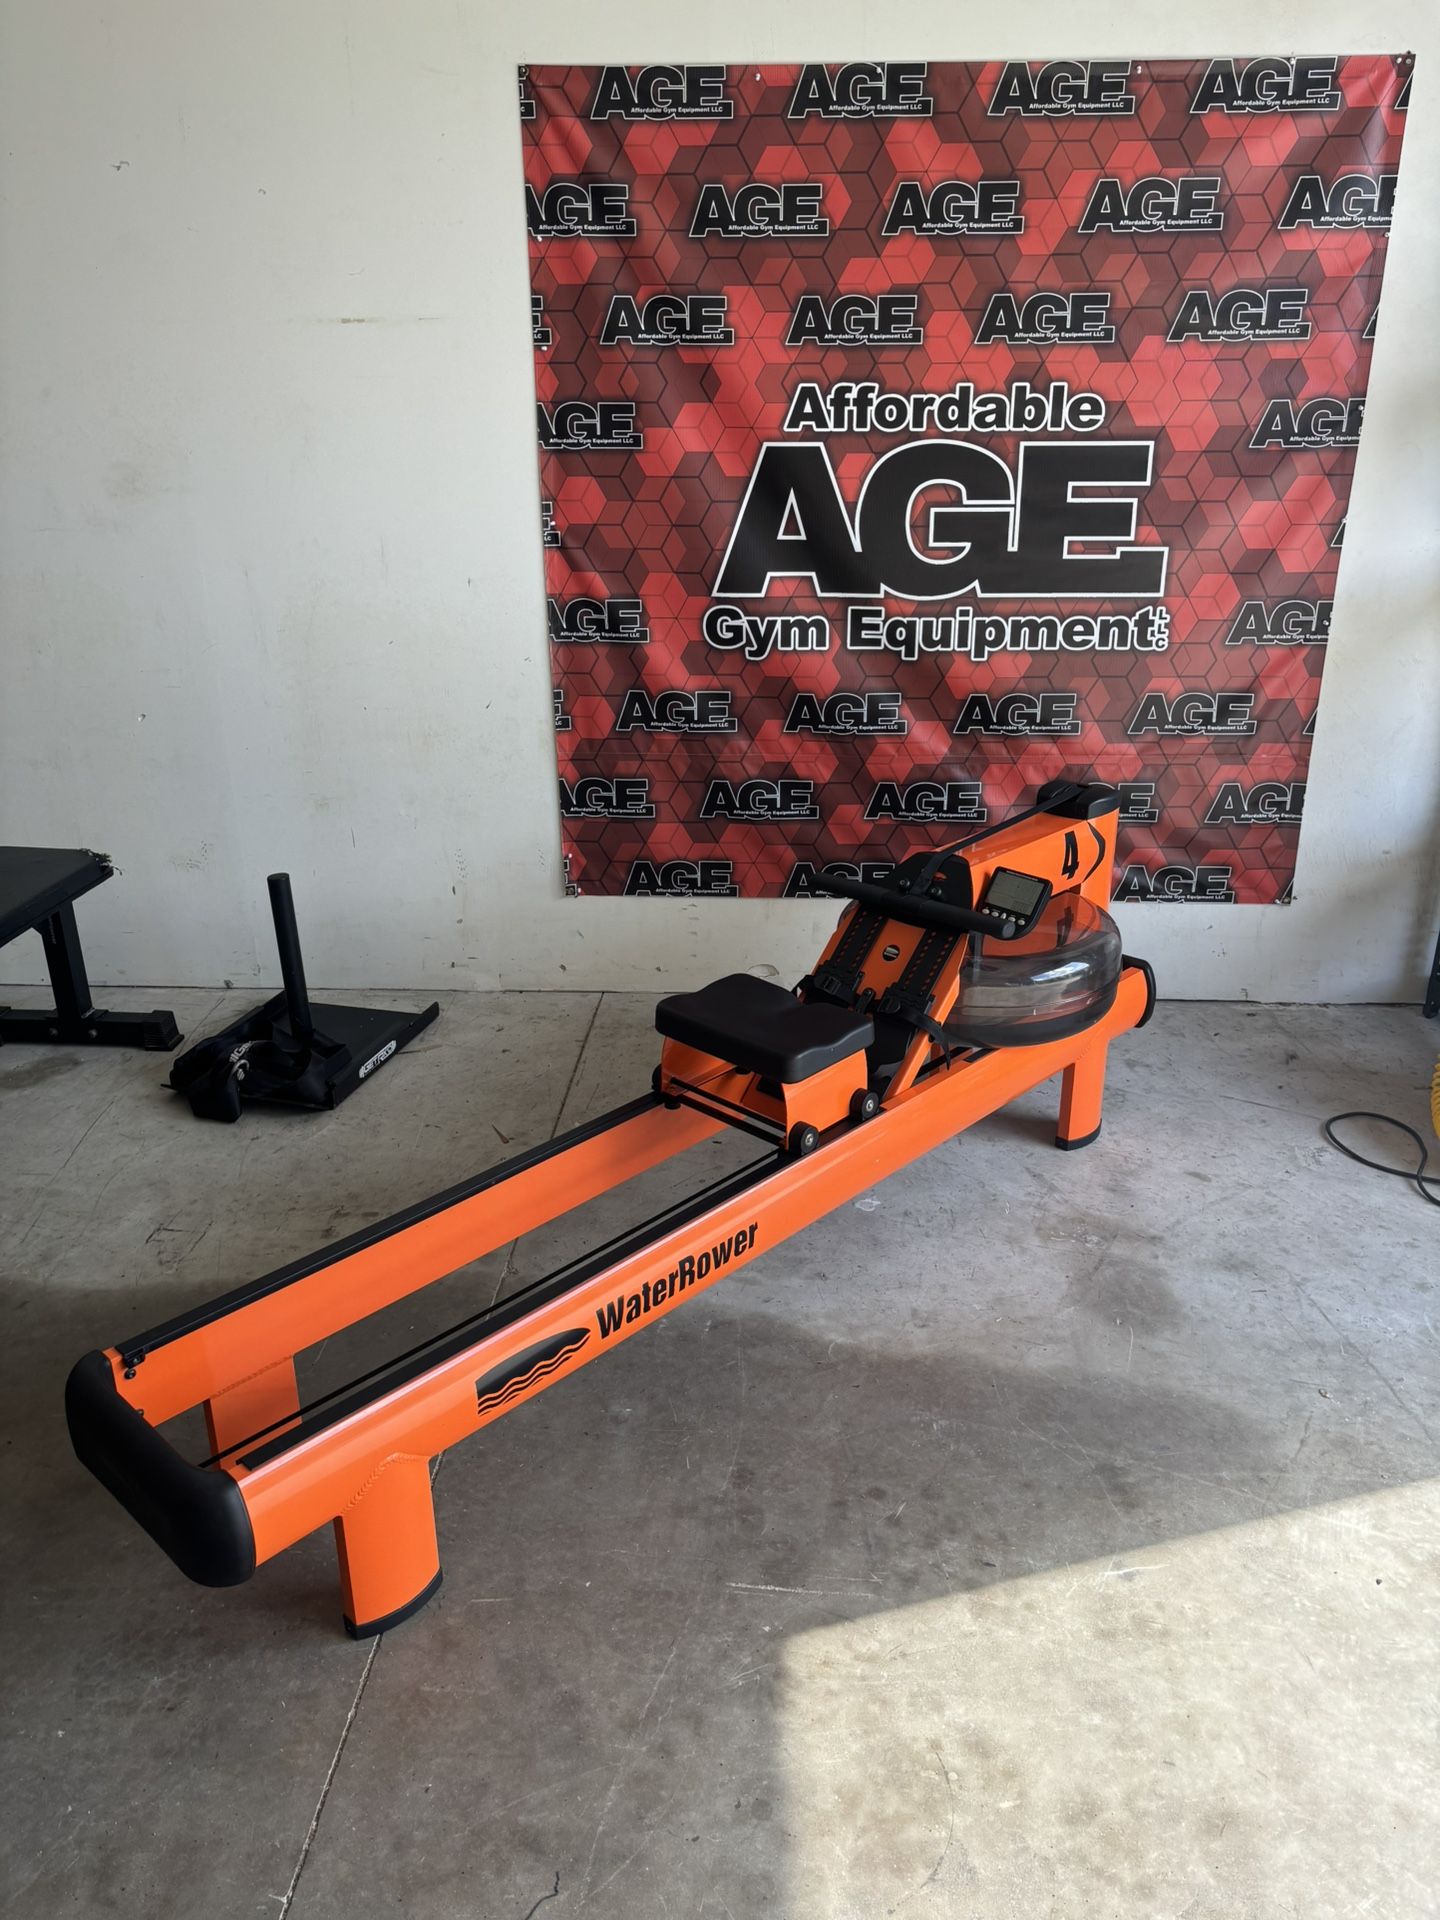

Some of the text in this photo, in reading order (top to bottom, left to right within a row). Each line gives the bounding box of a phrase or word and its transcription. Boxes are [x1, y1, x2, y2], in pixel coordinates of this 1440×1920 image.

[590, 64, 733, 120] AGE
[787, 61, 933, 118] AGE
[987, 60, 1135, 116] AGE
[1189, 56, 1341, 113] AGE
[689, 183, 829, 237] AGE
[882, 180, 1024, 235] AGE
[1078, 177, 1223, 232] AGE
[600, 295, 734, 345] AGE
[785, 294, 923, 345] AGE
[974, 292, 1115, 344] AGE
[1166, 289, 1311, 342] AGE
[783, 382, 1106, 432] Affordable
[711, 438, 1169, 600] AGE
[702, 605, 829, 660] Gym
[847, 606, 1156, 660] Equipment
[616, 690, 737, 732] AGE
[783, 692, 907, 734] AGE
[953, 693, 1081, 735] AGE
[1127, 692, 1257, 735] AGE
[699, 779, 818, 819] AGE
[863, 781, 986, 821] AGE
[623, 860, 738, 897] AGE
[1061, 830, 1079, 880] 4
[1111, 865, 1235, 903] AGE
[596, 1222, 758, 1339] WaterRower
